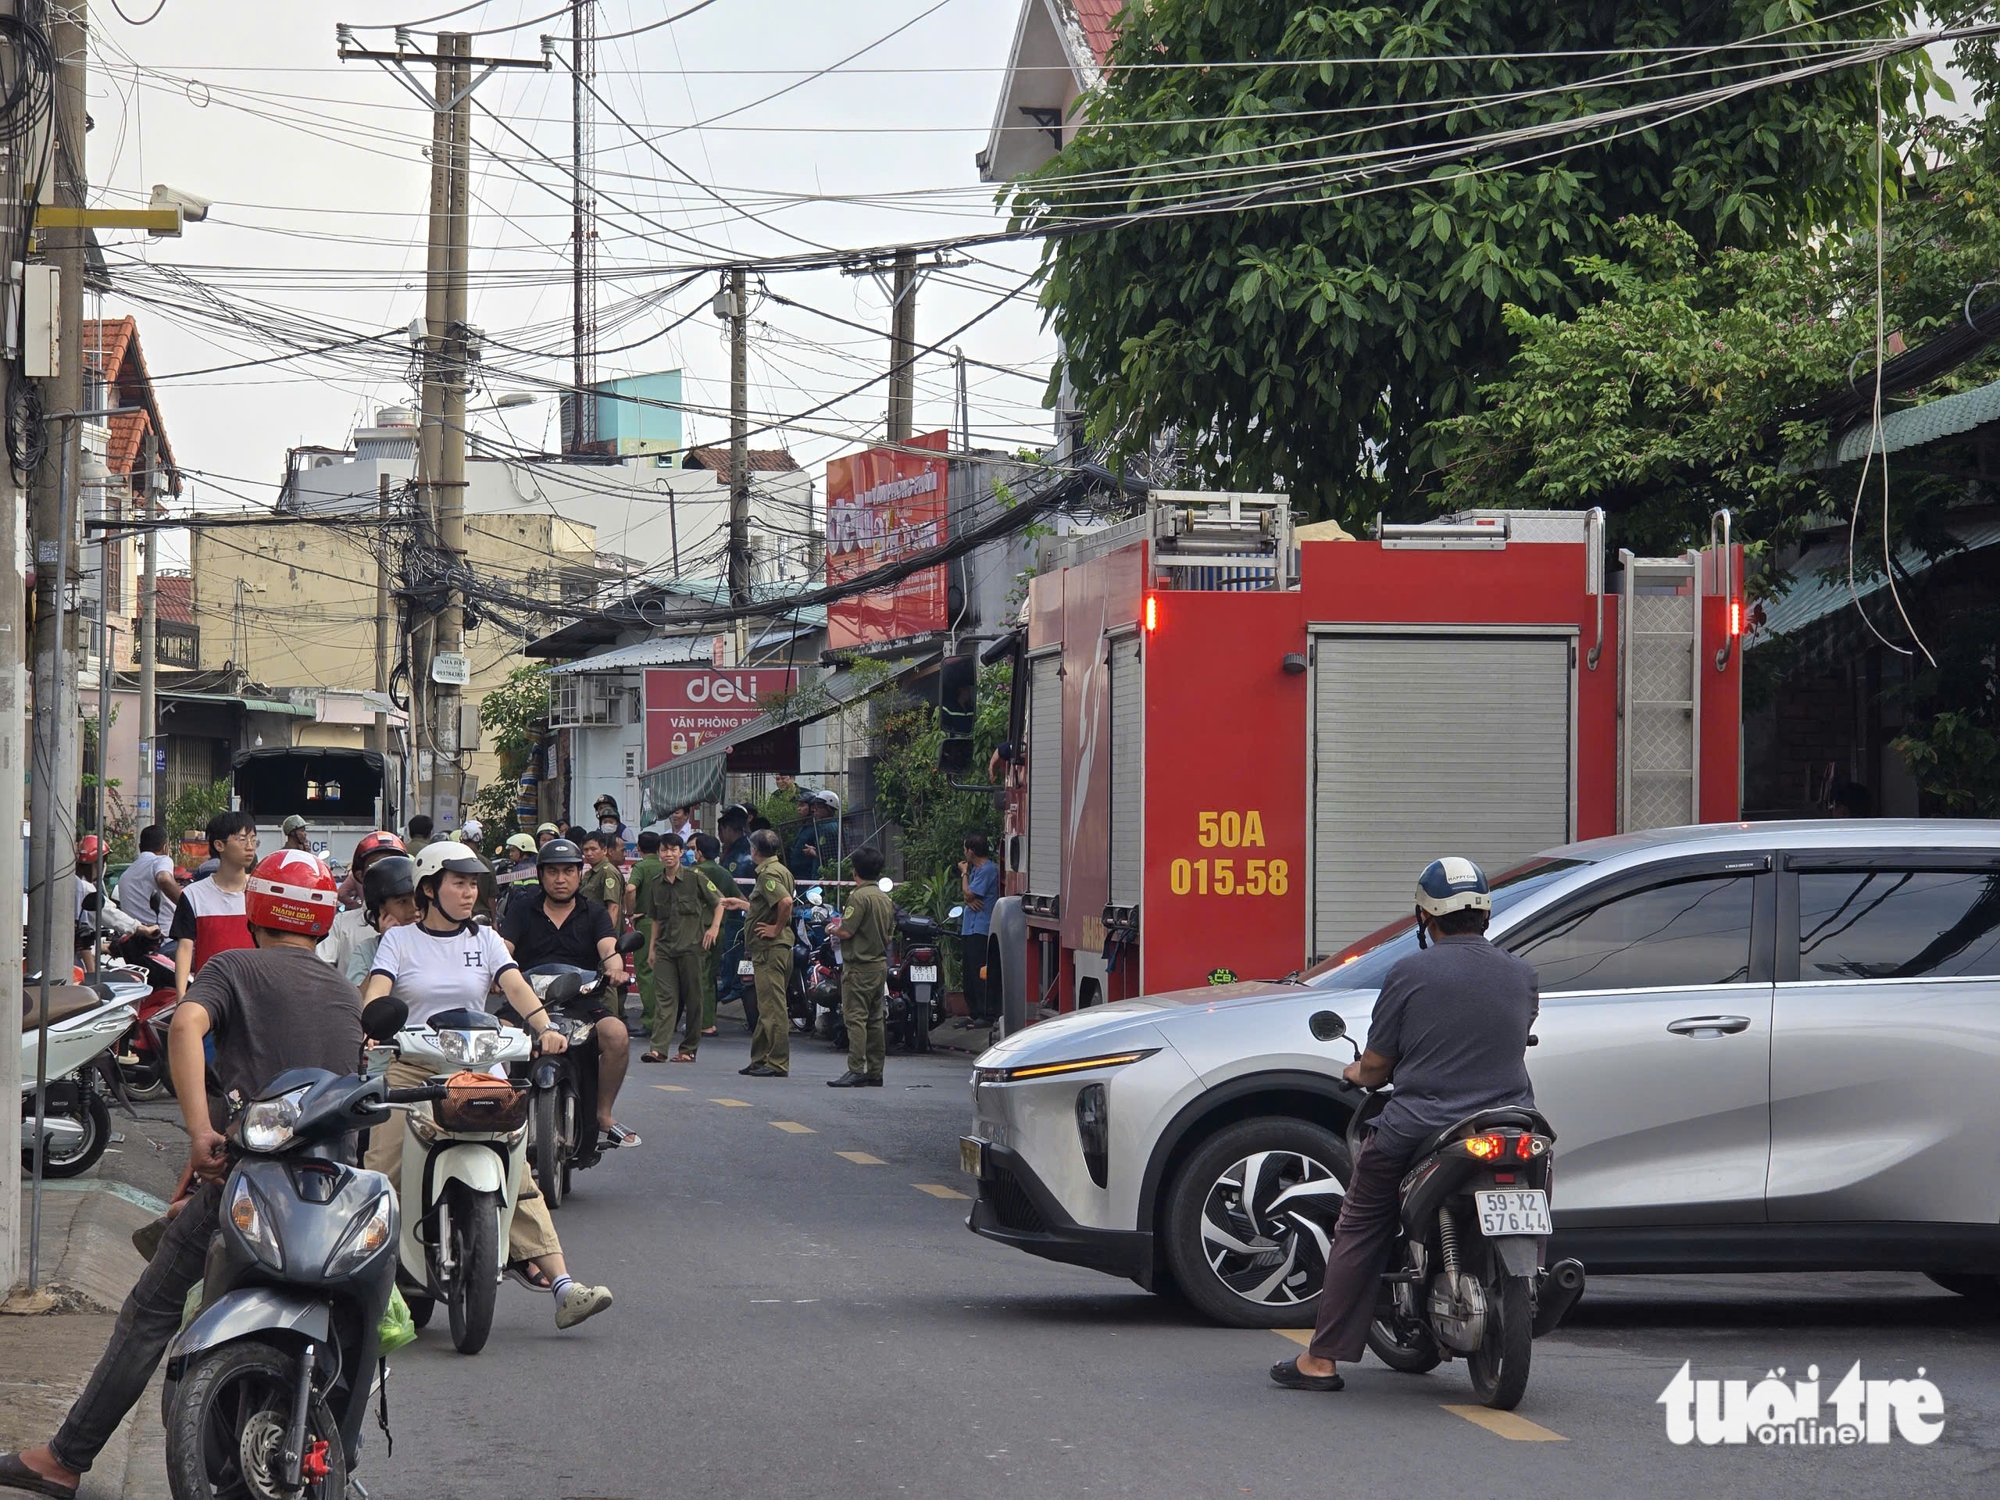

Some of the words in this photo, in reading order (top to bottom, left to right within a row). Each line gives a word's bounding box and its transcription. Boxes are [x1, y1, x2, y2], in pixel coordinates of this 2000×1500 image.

[687, 676, 756, 703] deli
[670, 715, 694, 728] VĂN
[697, 716, 739, 728] PHÒNG
[1198, 810, 1266, 848] 50A
[1170, 858, 1289, 896] 015.58
[463, 951, 483, 967] H
[1486, 1193, 1538, 1212] 59-X2
[1483, 1212, 1547, 1232] 576.44
